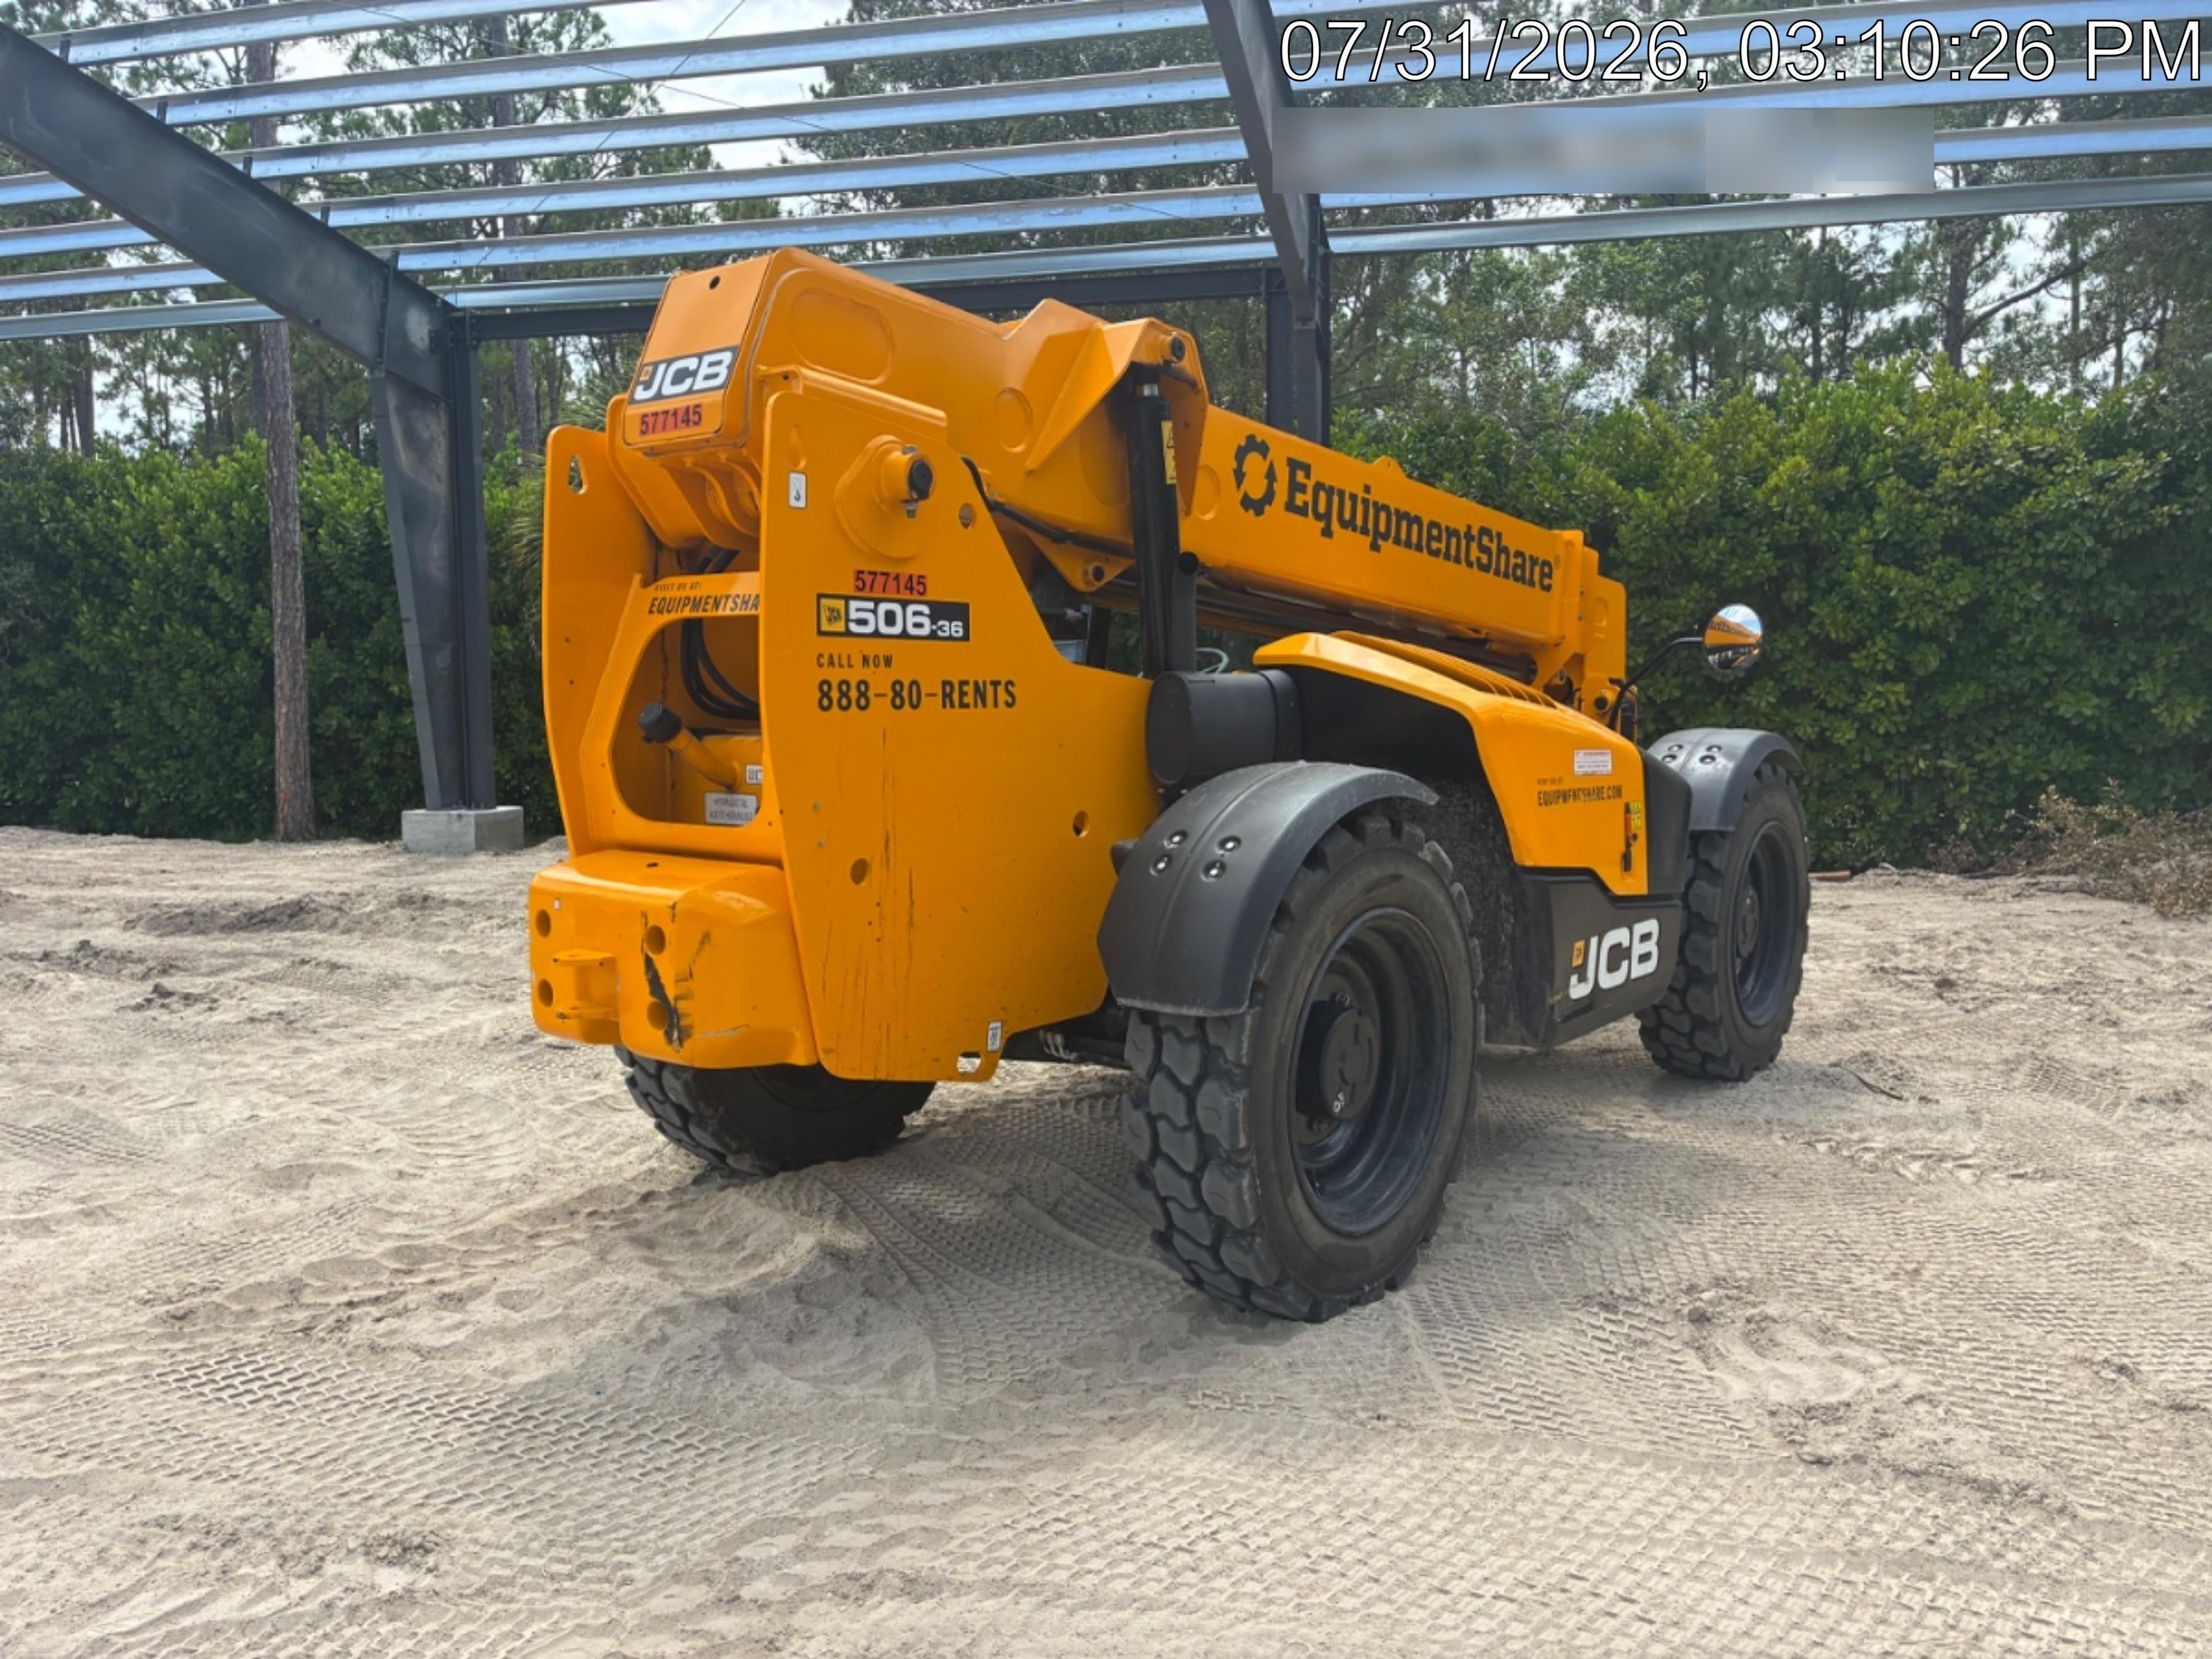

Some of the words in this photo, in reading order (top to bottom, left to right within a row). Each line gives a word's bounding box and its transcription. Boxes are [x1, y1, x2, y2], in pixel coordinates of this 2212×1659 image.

[634, 351, 733, 401] JCB
[640, 403, 703, 436] 577145
[854, 570, 927, 596] 577145
[816, 653, 854, 669] CALL
[862, 654, 893, 669] NOW
[818, 678, 1017, 712] 888-80-RENTS
[1569, 918, 1659, 1000] JCB
